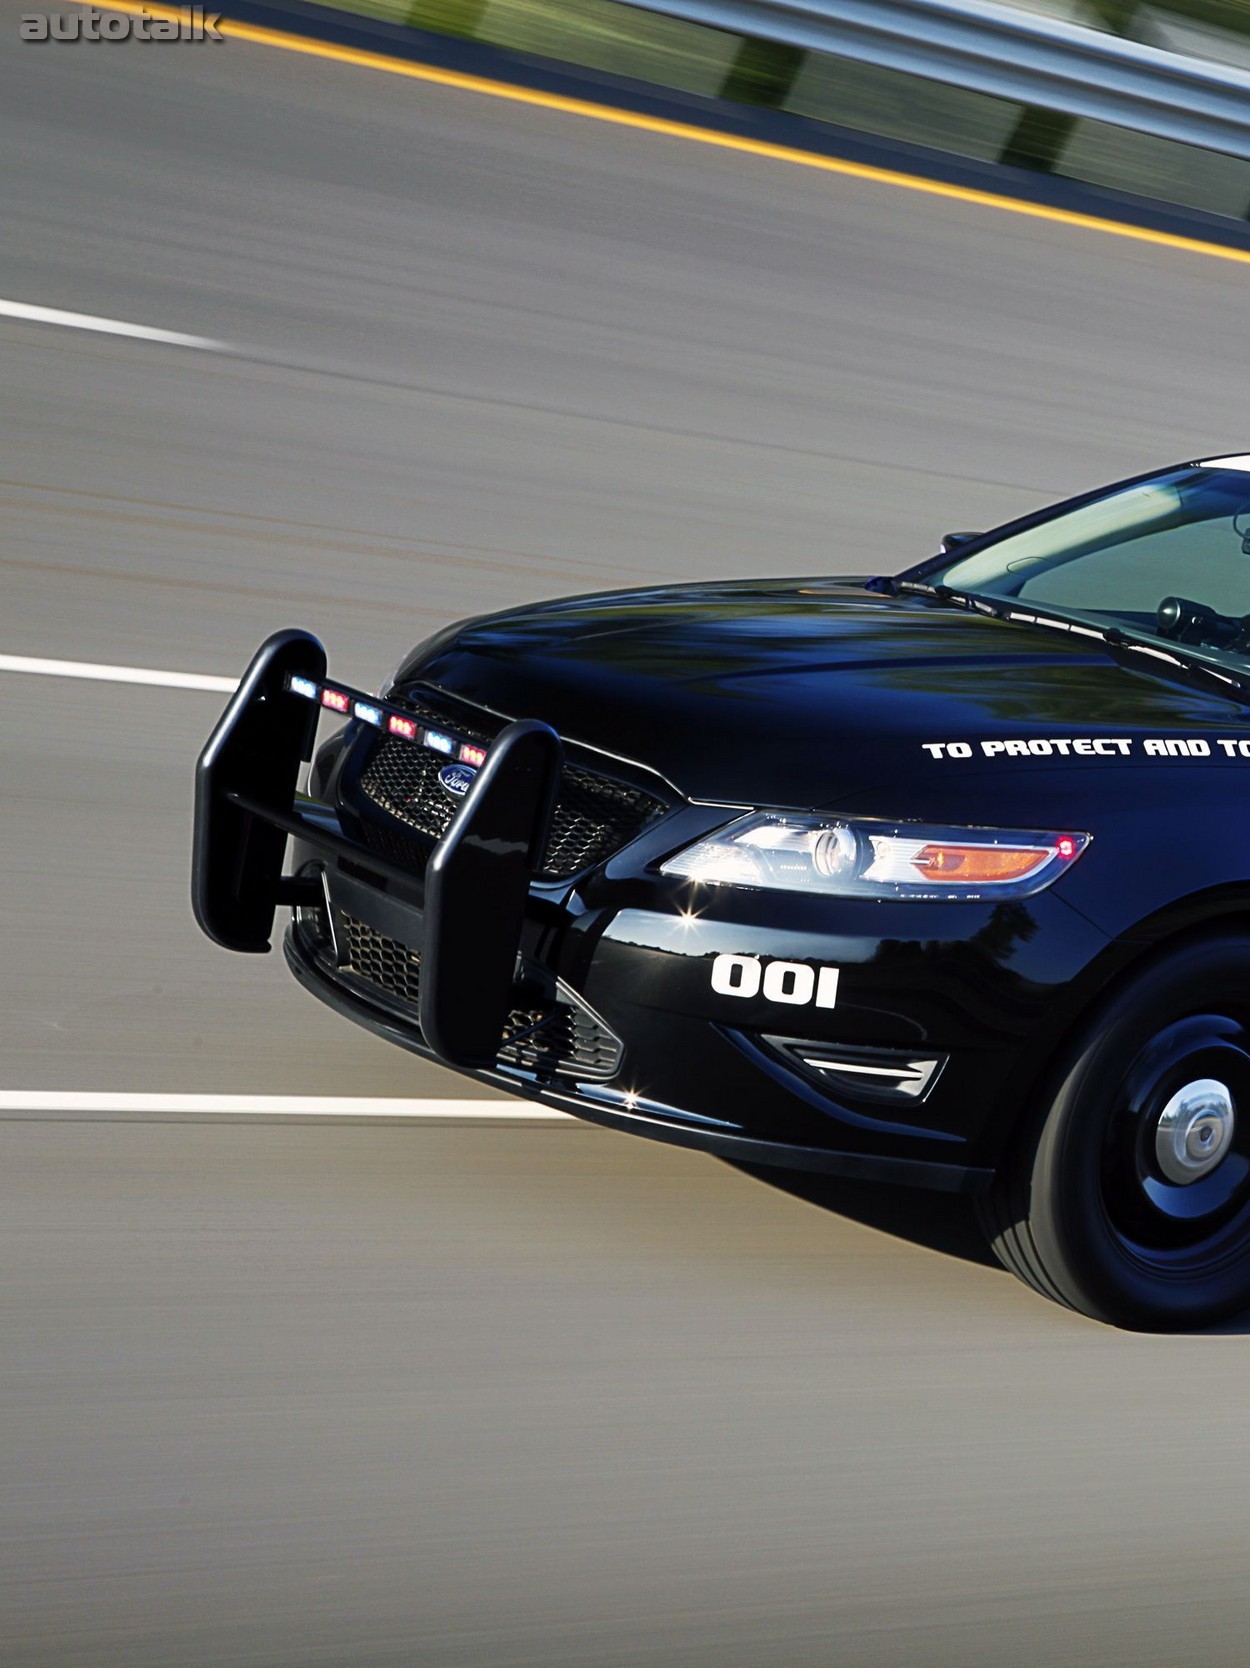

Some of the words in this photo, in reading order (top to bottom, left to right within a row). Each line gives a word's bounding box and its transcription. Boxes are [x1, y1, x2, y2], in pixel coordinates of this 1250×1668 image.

[922, 743, 972, 759] TO
[981, 738, 1132, 757] PROTECT
[1143, 739, 1210, 757] AND
[711, 953, 840, 1009] 001
